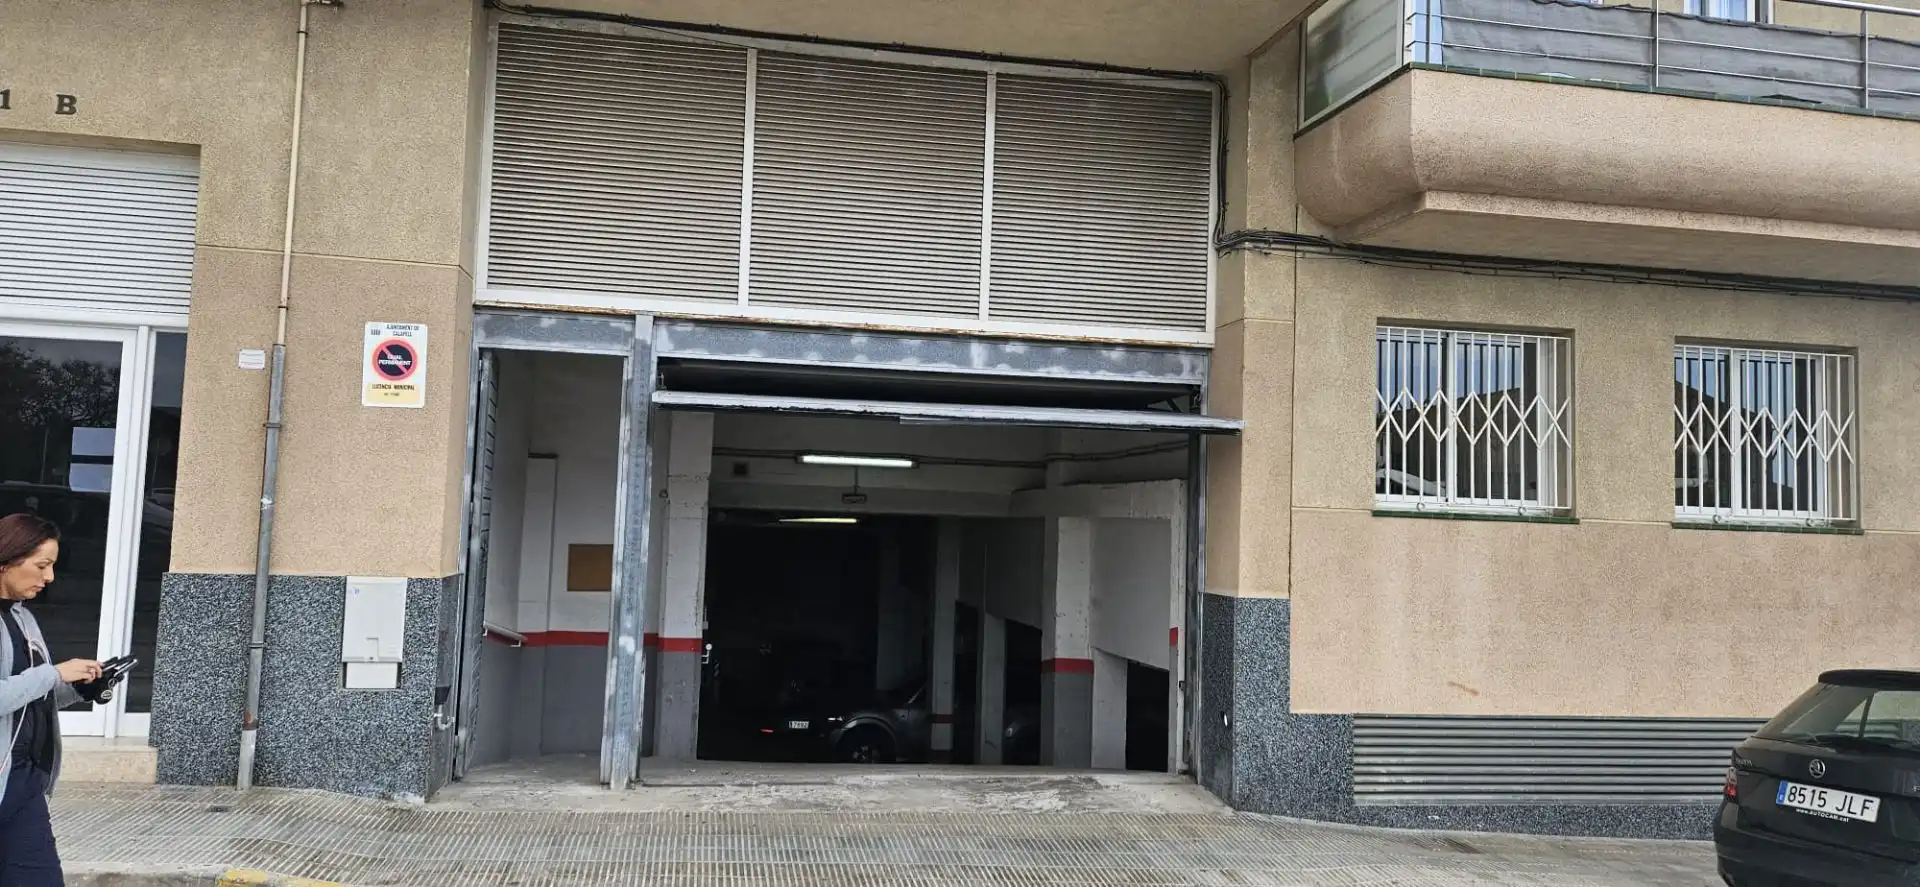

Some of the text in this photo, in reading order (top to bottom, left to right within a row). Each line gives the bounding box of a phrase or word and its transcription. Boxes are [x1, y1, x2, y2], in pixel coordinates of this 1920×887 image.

[55, 94, 77, 115] B
[1787, 785, 1875, 817] 8515 JLF
